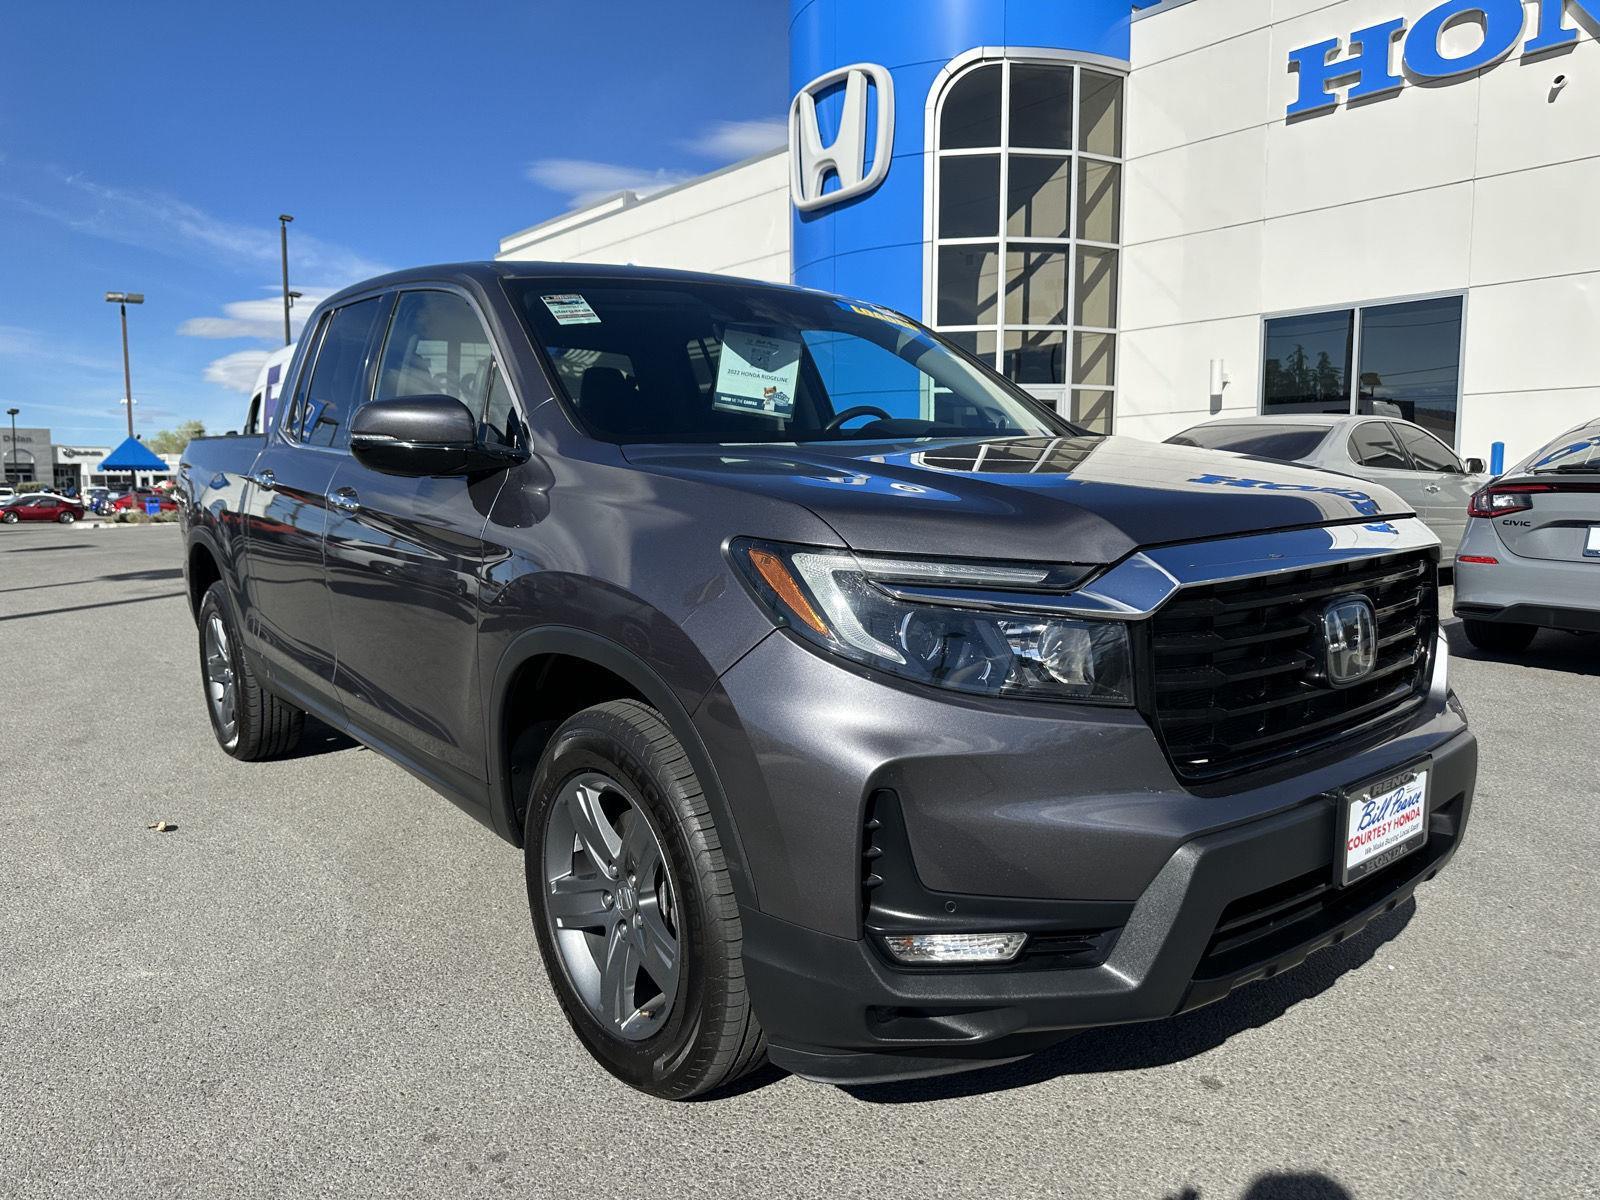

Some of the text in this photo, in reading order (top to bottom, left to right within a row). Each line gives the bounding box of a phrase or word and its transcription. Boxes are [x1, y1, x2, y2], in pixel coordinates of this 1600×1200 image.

[740, 371, 761, 379] HONDA
[761, 374, 789, 383] RIDGELINE
[1346, 807, 1421, 850] COURTESY HONDA
[1357, 787, 1421, 831] Bill Pearce
